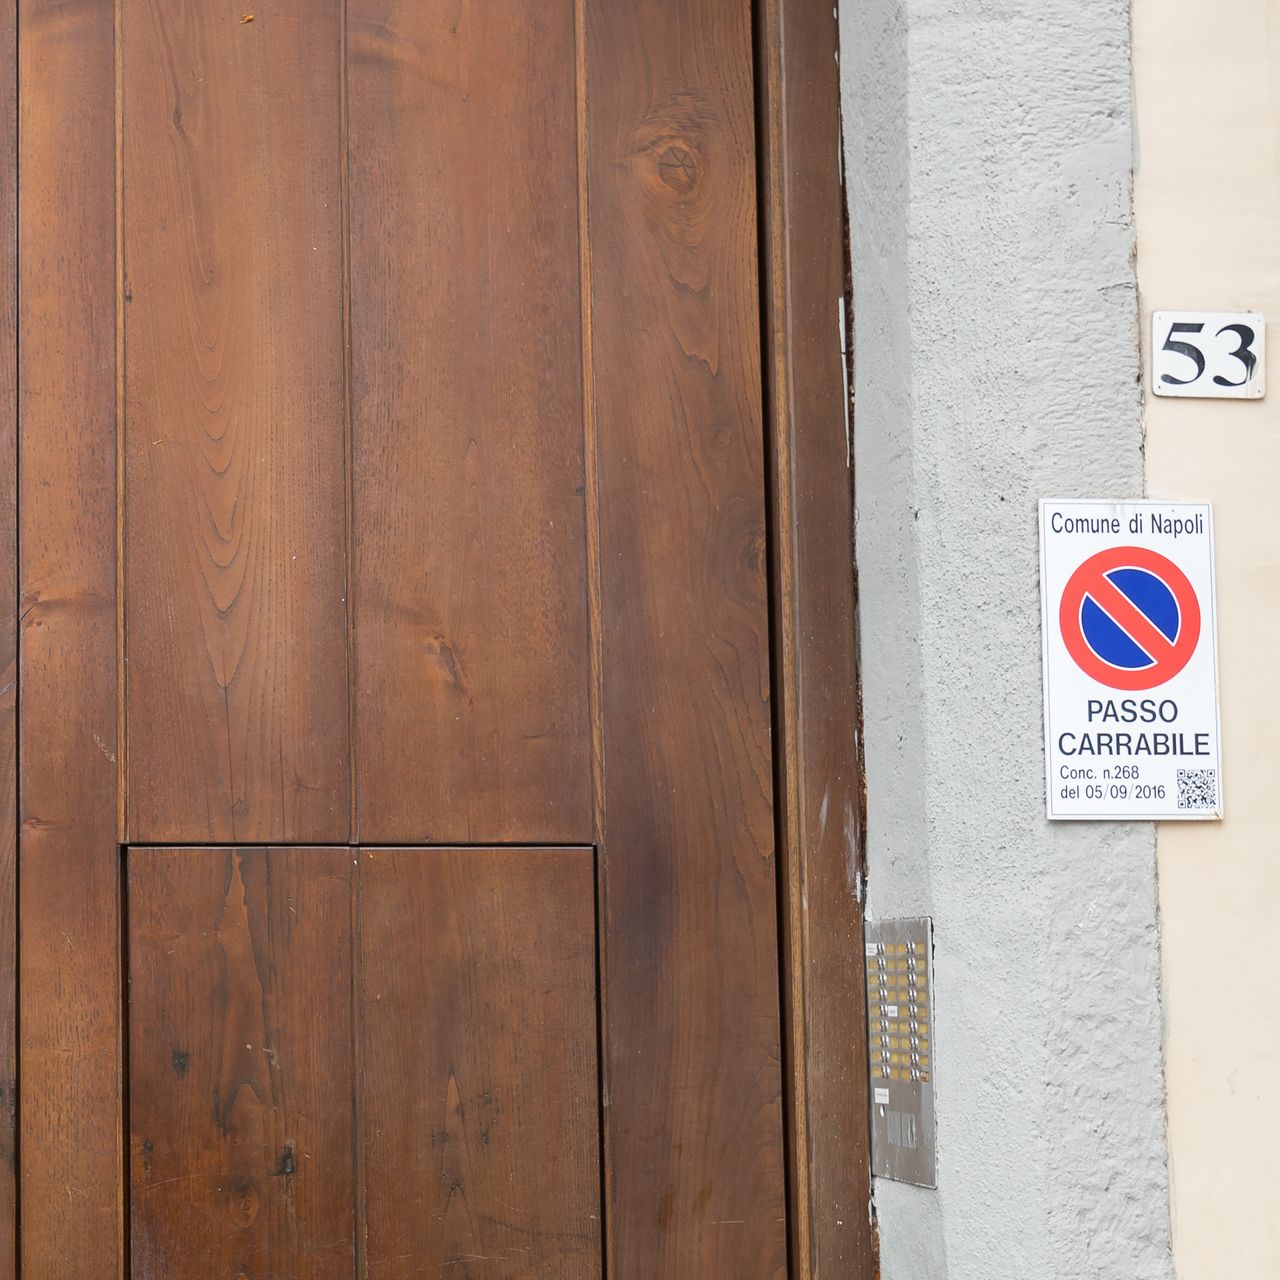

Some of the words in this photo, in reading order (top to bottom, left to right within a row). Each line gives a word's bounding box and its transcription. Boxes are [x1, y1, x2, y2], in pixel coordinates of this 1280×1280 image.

[1161, 322, 1257, 387] 53
[1051, 512, 1120, 533] Comune
[1129, 513, 1143, 534] di
[1151, 513, 1203, 538] Napoli
[1087, 699, 1178, 723] PASSO
[1058, 732, 1210, 756] CARRABILE
[1060, 765, 1097, 780] Conc.
[1103, 765, 1139, 780] n.268
[1060, 785, 1080, 799] del
[1085, 784, 1166, 800] 05/09/2016
